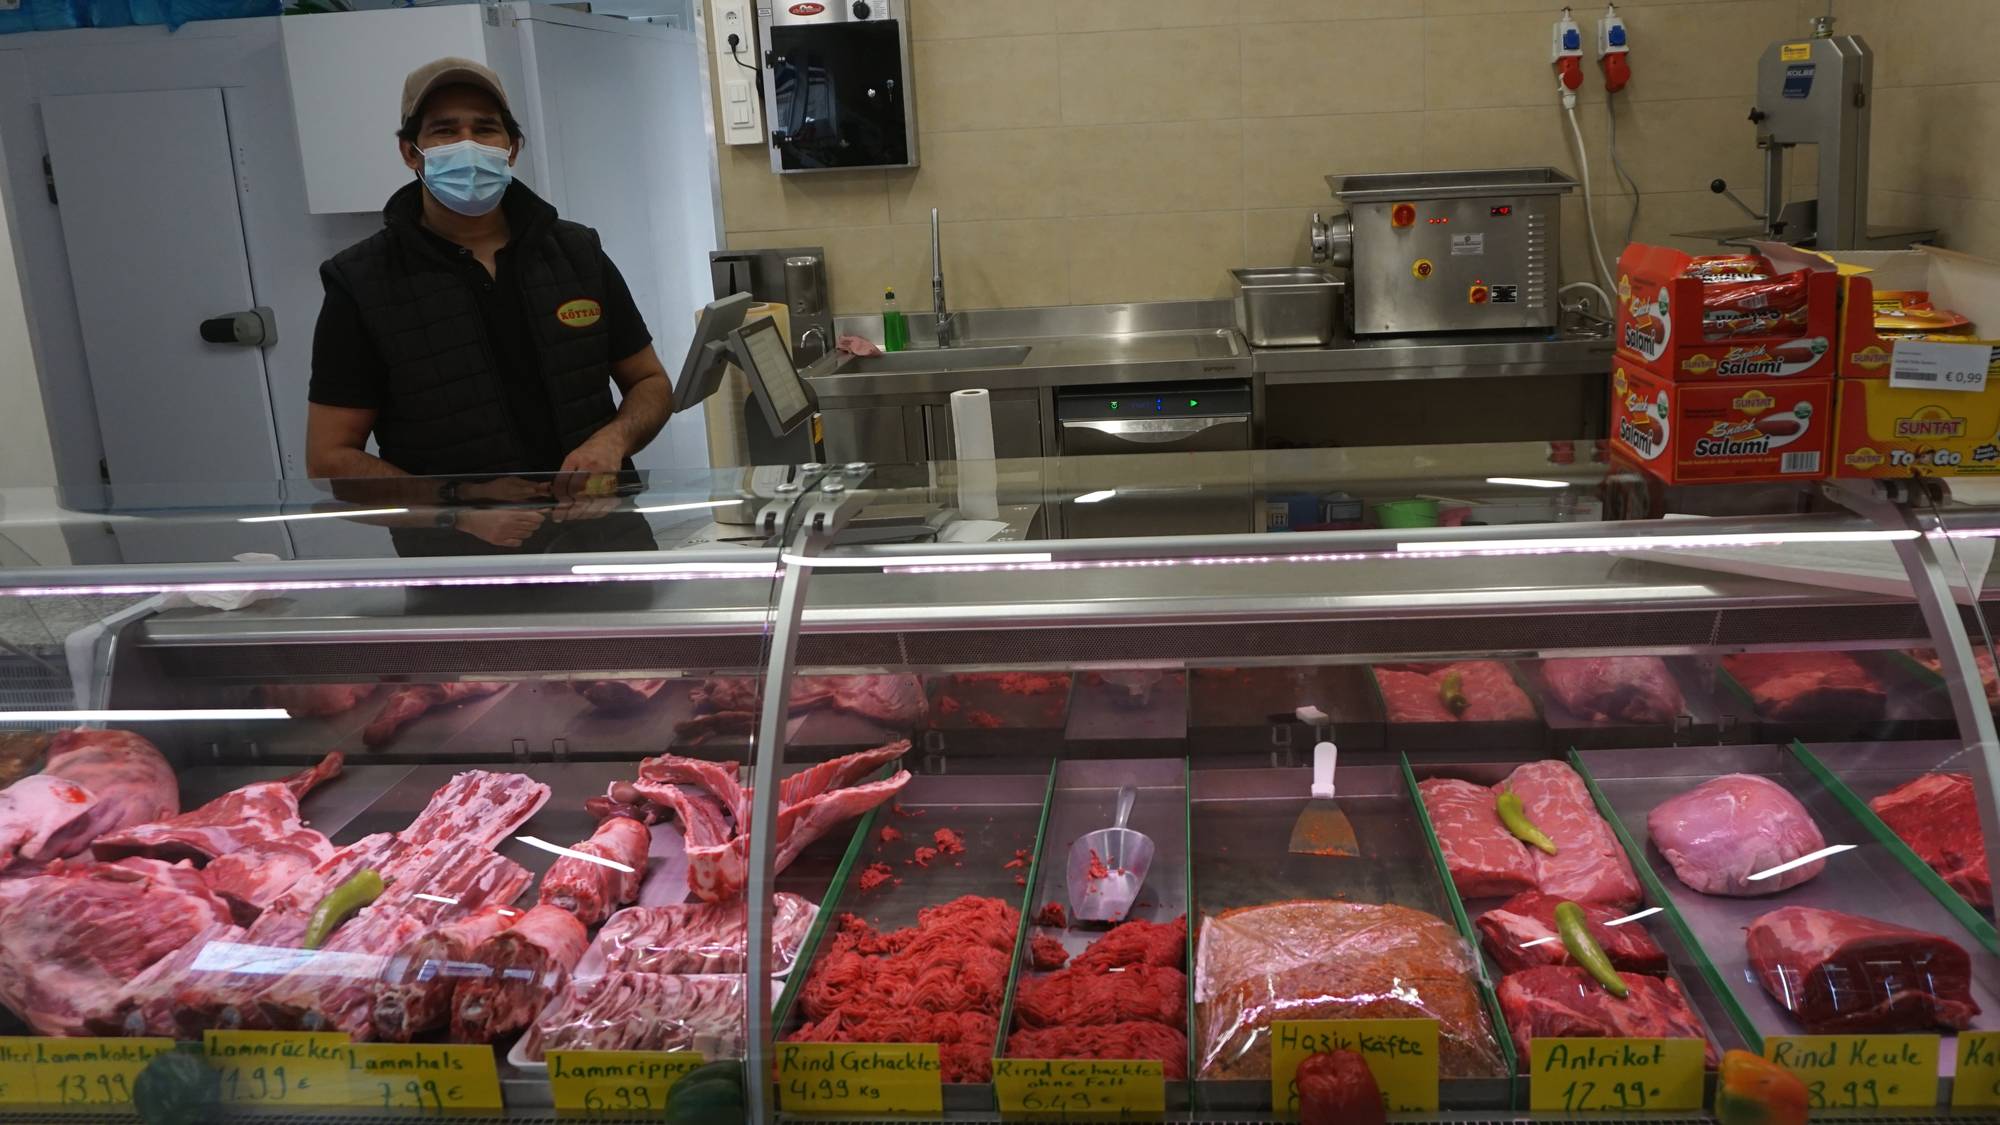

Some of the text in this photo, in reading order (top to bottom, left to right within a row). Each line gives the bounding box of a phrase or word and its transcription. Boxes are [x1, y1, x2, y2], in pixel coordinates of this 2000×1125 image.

[1624, 321, 1655, 357] Salami
[1717, 356, 1784, 375] Salami
[1945, 371, 1983, 384] € 0,99
[1619, 415, 1652, 456] Salami
[1899, 421, 1962, 435] SUNTAT
[1695, 433, 1770, 456] Salami
[1890, 449, 1915, 466] To
[1934, 449, 1962, 466] Go
[348, 1049, 464, 1071] Lammhals
[782, 1047, 834, 1072] Rind
[1545, 1044, 1665, 1072] Antrikot
[1773, 1039, 1923, 1069] Rind Keule
[1964, 1037, 2000, 1067] Ka
[997, 1062, 1052, 1078] Rind
[447, 1086, 464, 1101] €
